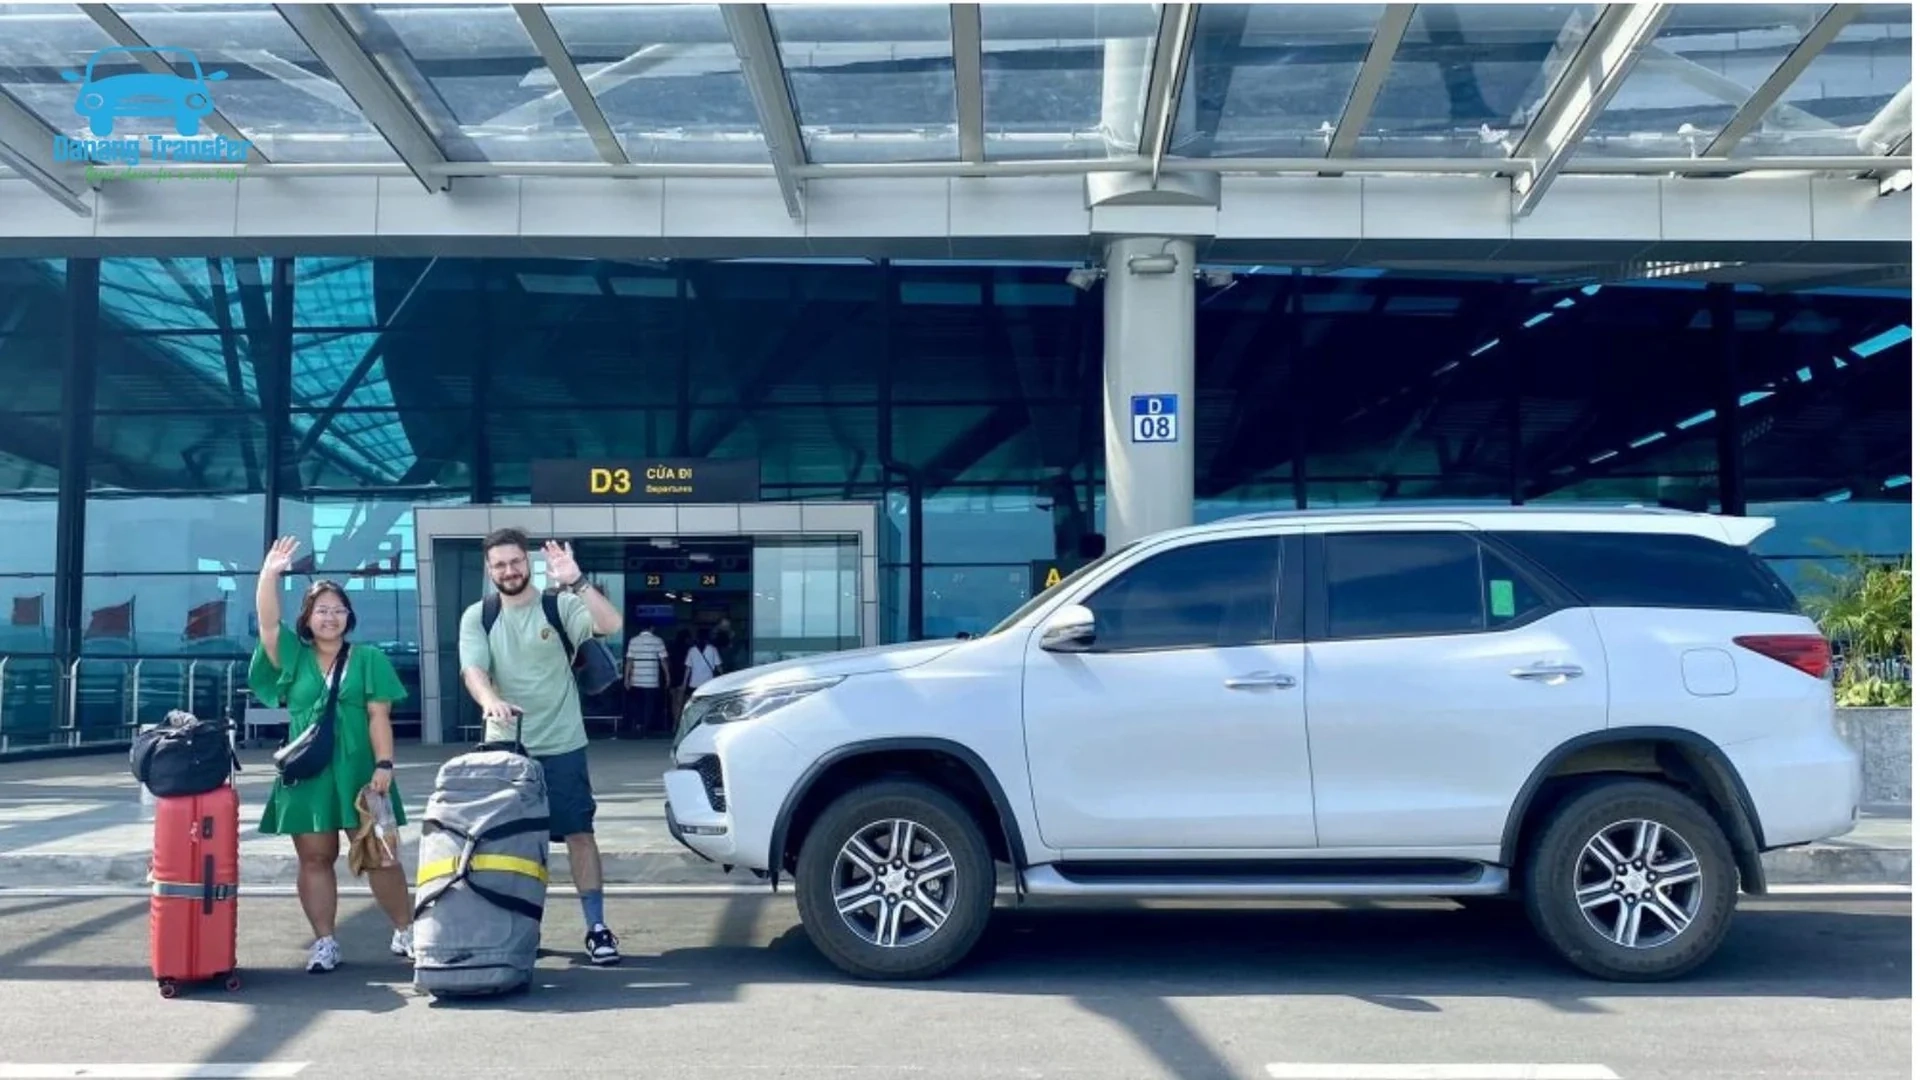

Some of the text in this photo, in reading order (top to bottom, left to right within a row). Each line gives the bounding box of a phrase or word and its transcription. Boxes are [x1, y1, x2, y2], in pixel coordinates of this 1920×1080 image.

[1149, 399, 1162, 414] D
[1140, 417, 1170, 438] 08
[646, 464, 675, 479] CỬA
[590, 468, 632, 494] D3
[647, 575, 660, 586] 23
[703, 575, 716, 586] 24
